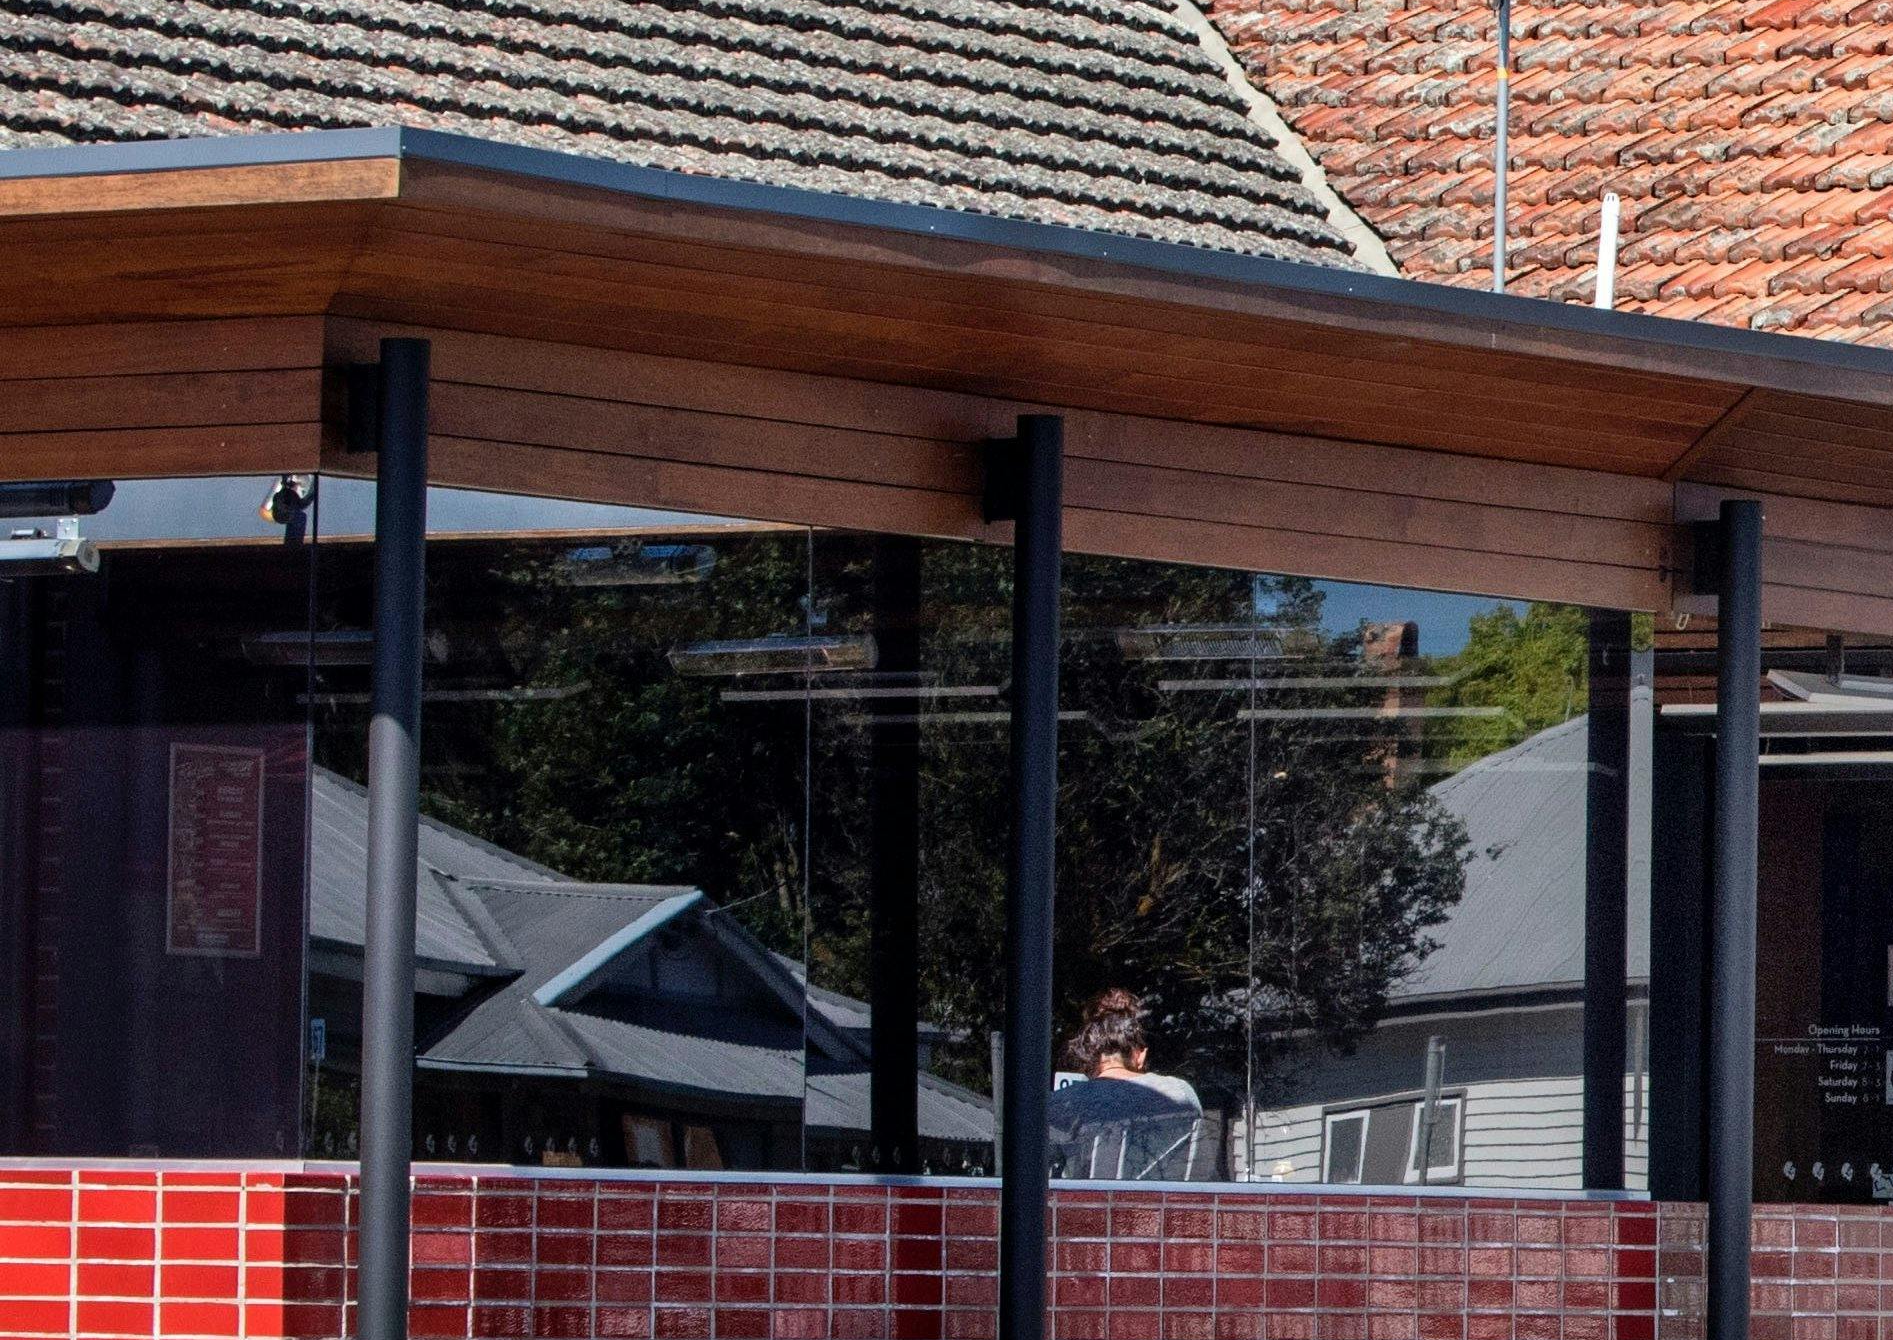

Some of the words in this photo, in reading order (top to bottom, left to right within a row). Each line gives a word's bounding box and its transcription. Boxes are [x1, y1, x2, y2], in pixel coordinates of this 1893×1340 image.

[1808, 1023, 1849, 1037] Opening
[1851, 1023, 1881, 1036] Hours
[1774, 1044, 1809, 1055] Monday
[1818, 1043, 1858, 1056] Thursday
[1830, 1060, 1858, 1073] Friday
[1818, 1076, 1858, 1089] Saturday
[1825, 1093, 1858, 1105] Sunday
